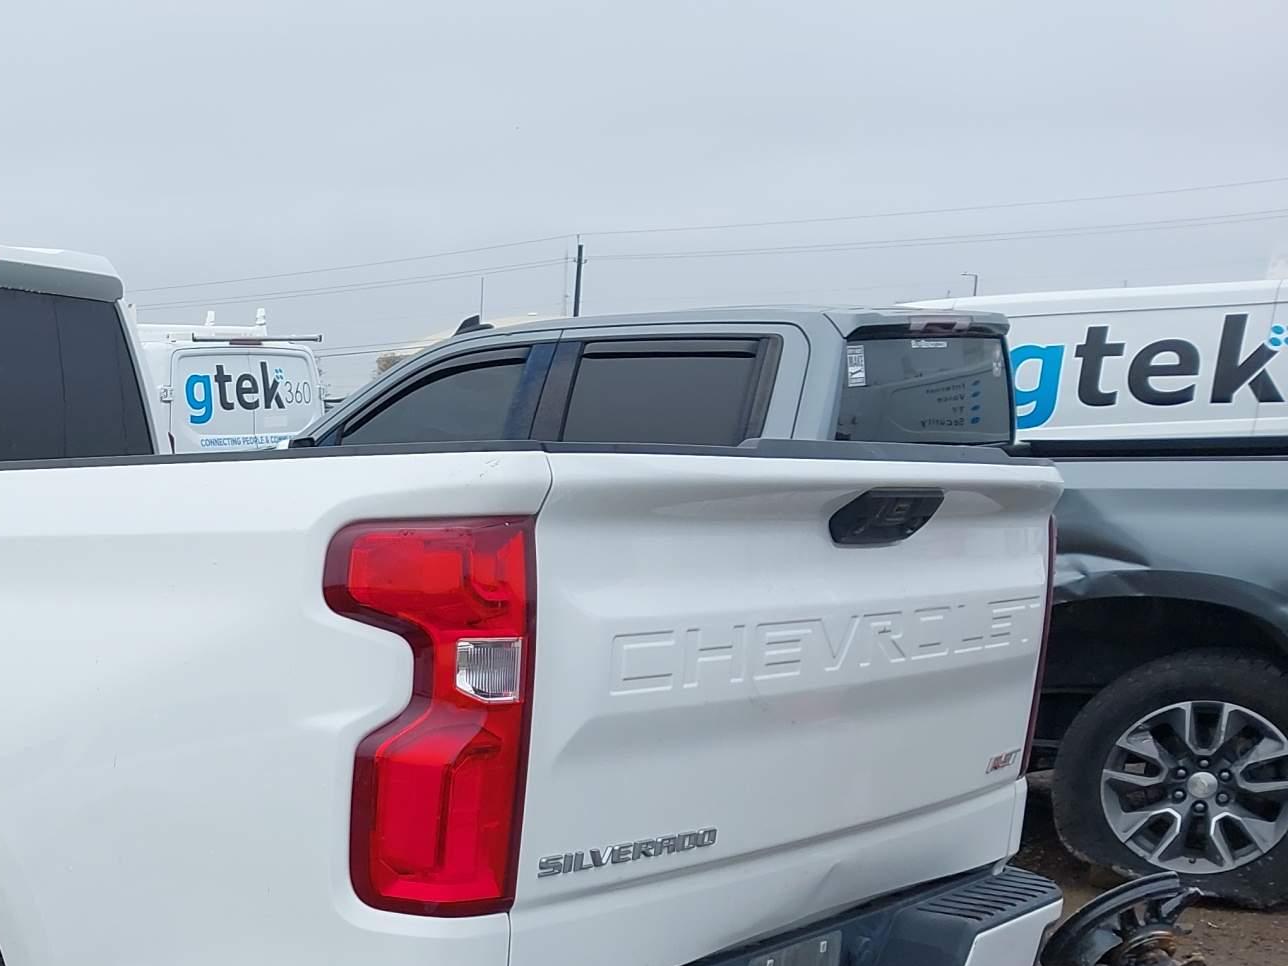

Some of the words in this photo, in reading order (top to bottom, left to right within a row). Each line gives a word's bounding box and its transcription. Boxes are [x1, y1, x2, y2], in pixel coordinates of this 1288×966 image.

[185, 361, 286, 424] gtek
[284, 380, 312, 405] 360
[1009, 313, 1286, 430] gtek
[537, 827, 718, 879] SILVERADO
